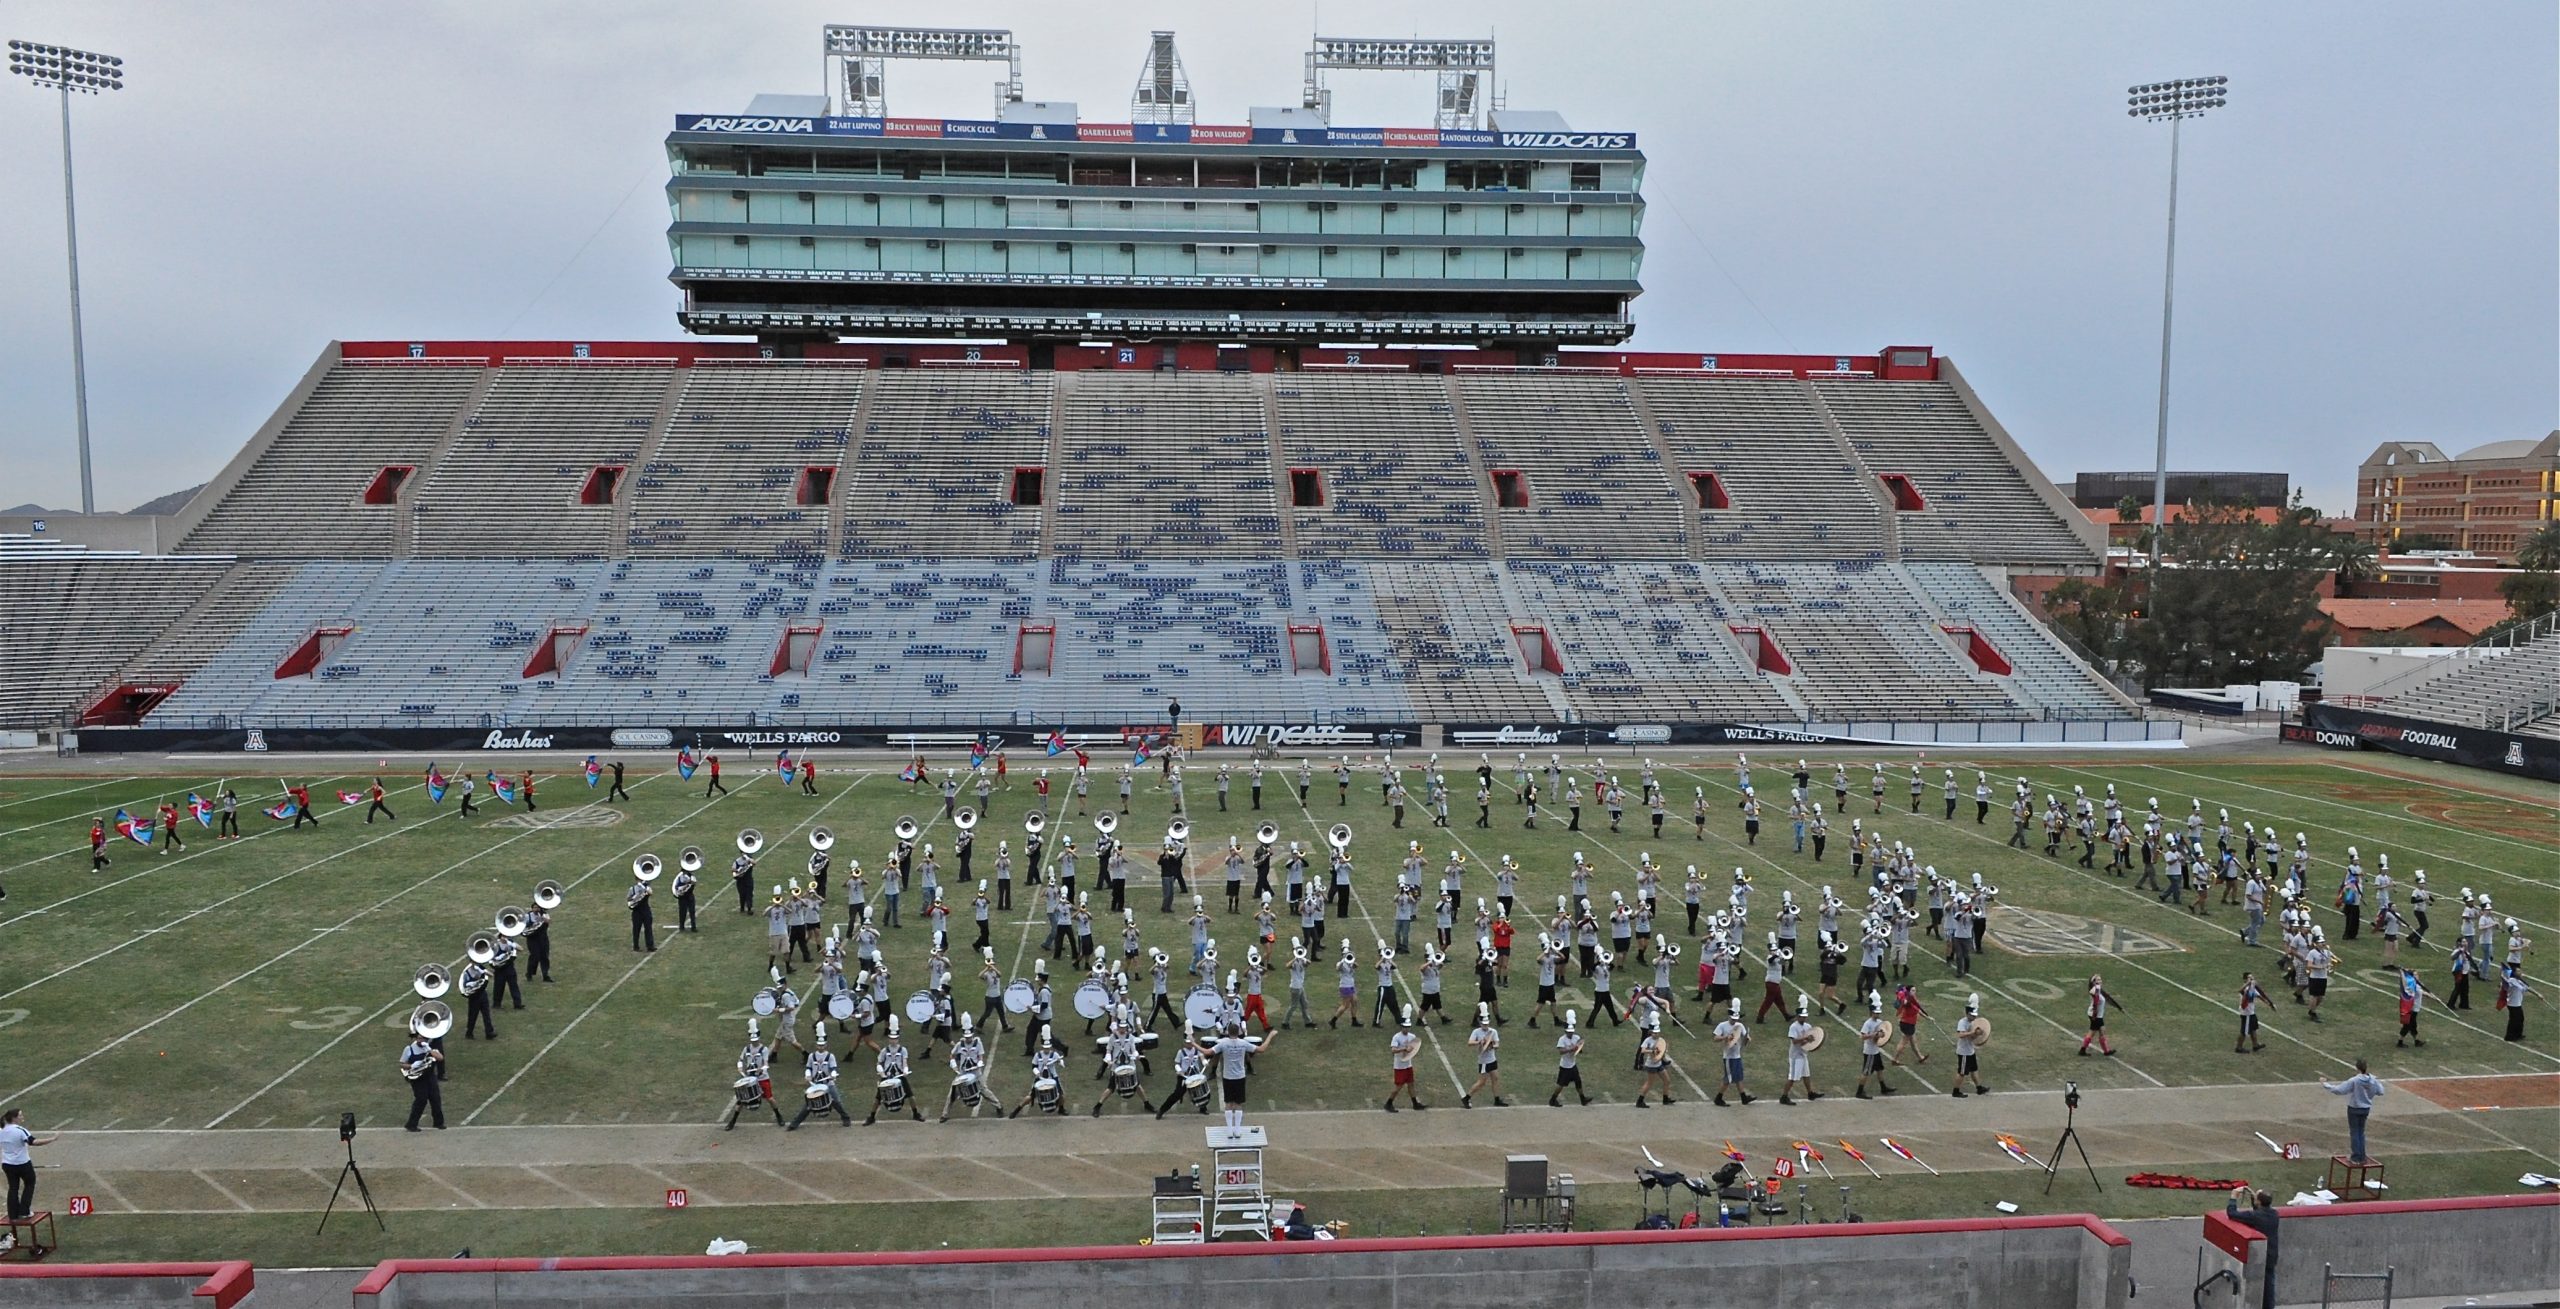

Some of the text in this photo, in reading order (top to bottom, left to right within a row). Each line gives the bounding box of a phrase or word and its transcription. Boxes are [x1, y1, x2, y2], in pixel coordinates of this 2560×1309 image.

[691, 118, 812, 132] ARIZONA
[838, 122, 851, 130] ART
[852, 122, 881, 130] LUPPINO
[895, 123, 914, 131] RICKY
[915, 123, 941, 132] HUNLEY
[953, 124, 976, 133] CHUCK
[977, 126, 996, 134] CECIL
[1083, 129, 1112, 137] DARRYLL
[1113, 129, 1133, 137] LEWIS
[1200, 130, 1213, 138] ROB
[1213, 130, 1246, 138] WALDROP
[1390, 133, 1407, 141] CHRIS
[1445, 134, 1471, 143] ANTOINE
[1472, 134, 1494, 143] CASON
[1503, 134, 1629, 148] WILDCATS
[411, 349, 423, 358] 17
[575, 349, 588, 358] 18
[761, 350, 773, 359] 19
[966, 351, 981, 360] 20
[1120, 352, 1132, 362] 21
[1347, 356, 1360, 365] 22
[1544, 358, 1557, 367] 23
[1703, 360, 1715, 369] 24
[1836, 363, 1849, 372] 25
[33, 521, 45, 530] 16
[482, 730, 553, 748] Bashas'
[731, 732, 841, 743] WELLS FARGO
[1724, 728, 1774, 741] WELLS
[2316, 731, 2355, 746] DOWN
[2400, 729, 2457, 750] FOOTBALL
[2286, 1143, 2300, 1159] 30
[1775, 1159, 1790, 1176] 40
[1228, 1170, 1245, 1184] 50
[668, 1190, 685, 1207] 40
[71, 1197, 88, 1215] 30
